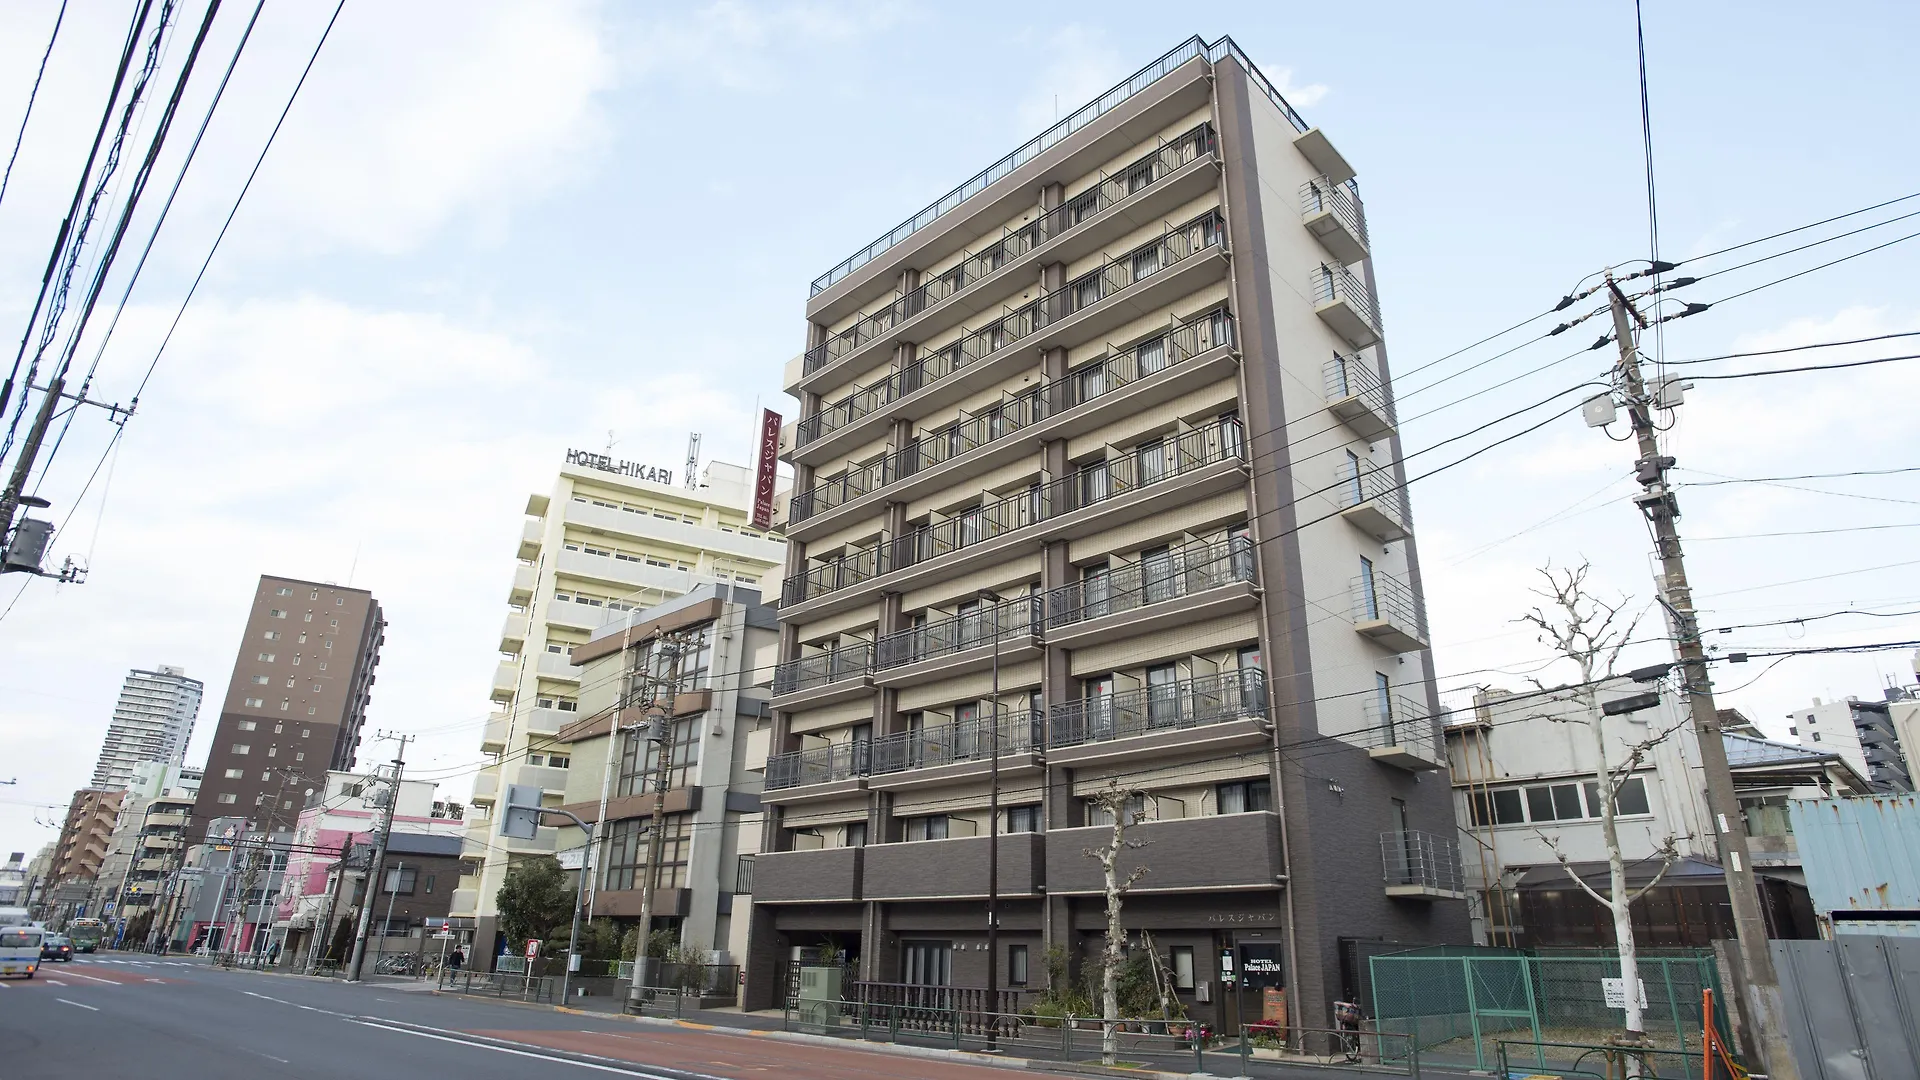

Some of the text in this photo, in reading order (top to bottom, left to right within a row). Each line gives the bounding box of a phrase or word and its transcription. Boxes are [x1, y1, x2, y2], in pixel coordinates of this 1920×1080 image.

[566, 448, 672, 485] HOTEL HIKARI
[760, 416, 779, 496] パレスジャパン
[1244, 963, 1280, 971] Palace JAPAN
